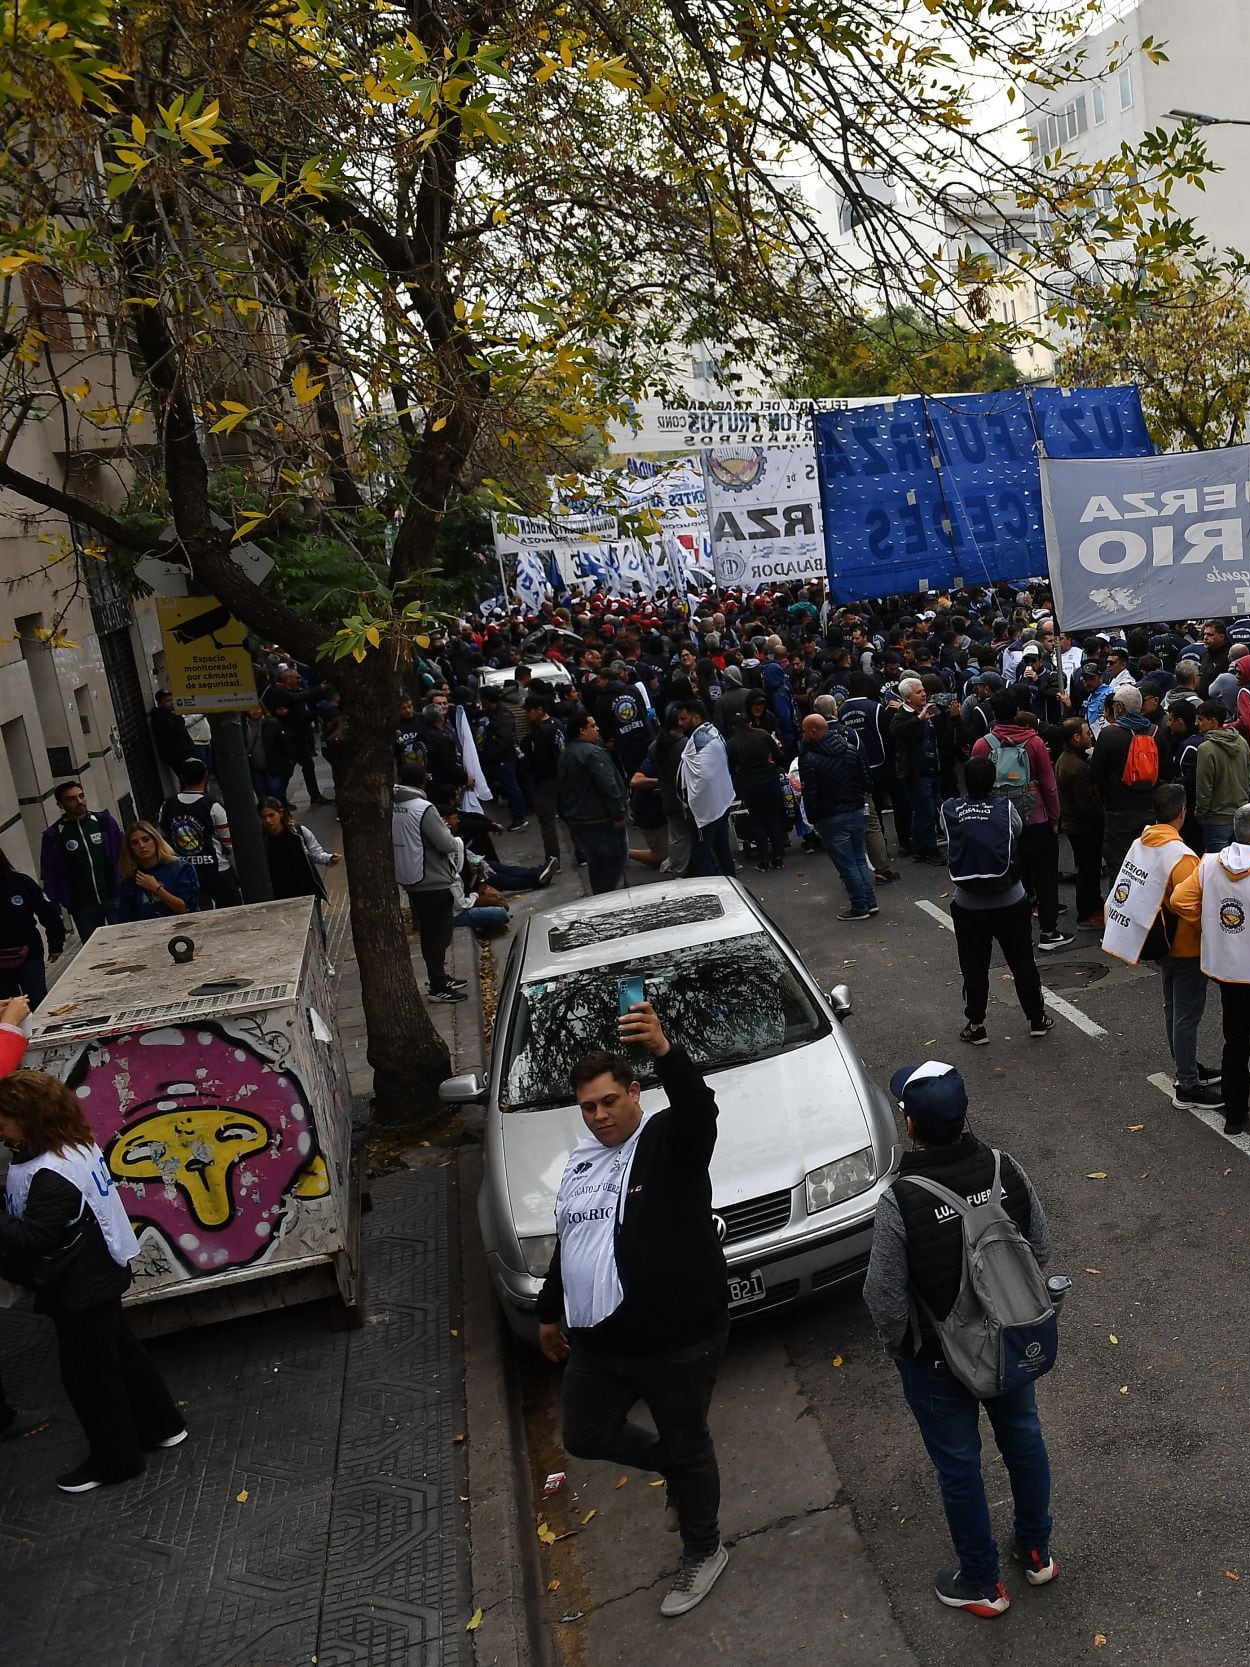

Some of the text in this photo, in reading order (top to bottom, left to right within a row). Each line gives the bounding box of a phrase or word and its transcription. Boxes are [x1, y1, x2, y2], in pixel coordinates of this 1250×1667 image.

[192, 655, 226, 664] Espacio
[184, 662, 238, 673] monitoreado
[187, 671, 238, 682] por cámaras
[185, 679, 242, 690] de seguridad.
[1124, 861, 1149, 880] ESTION
[966, 1186, 1007, 1206] FUERA
[730, 1278, 762, 1301] 821
